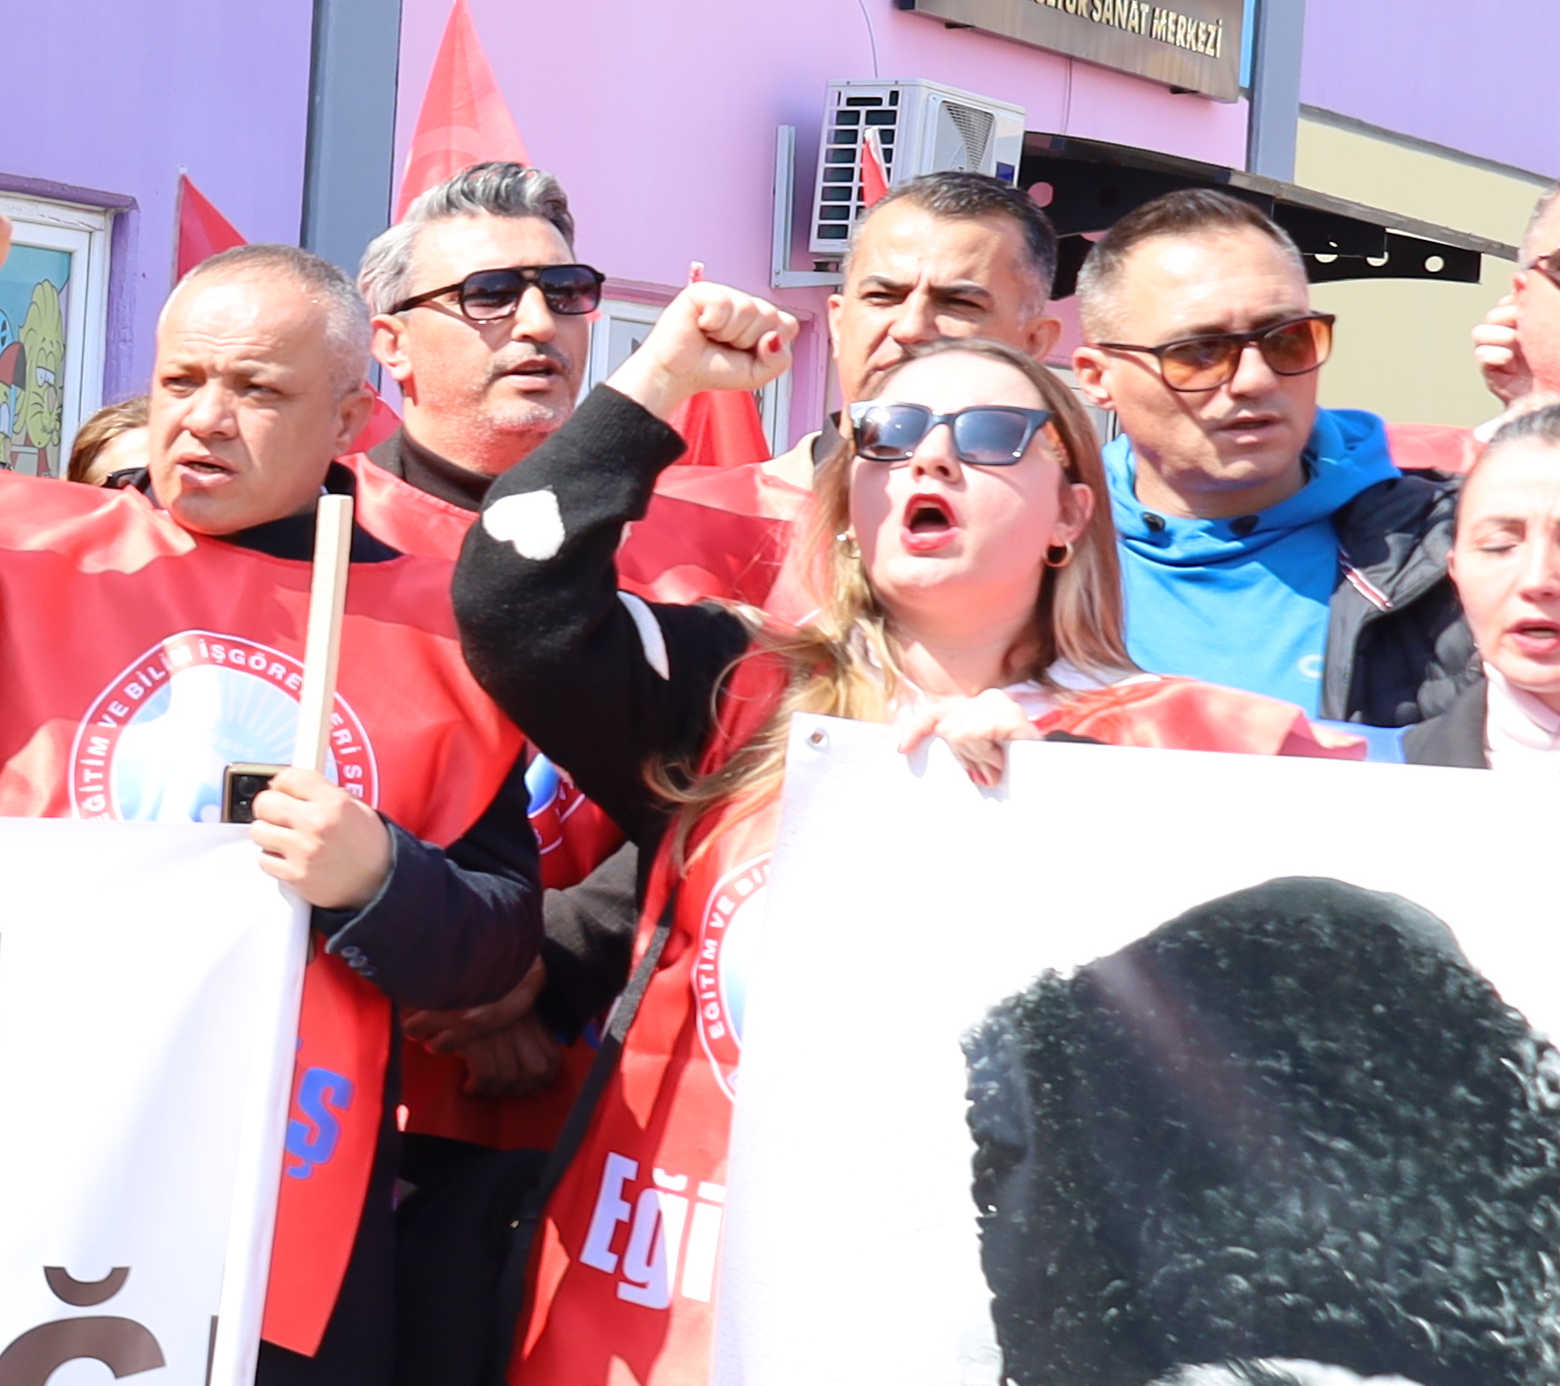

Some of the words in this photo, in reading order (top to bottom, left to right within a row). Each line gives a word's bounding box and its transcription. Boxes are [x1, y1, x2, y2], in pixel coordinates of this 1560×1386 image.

[1151, 7, 1223, 58] MERKEZİ
[97, 700, 130, 728] VE
[199, 638, 362, 755] İŞGÖREERİ
